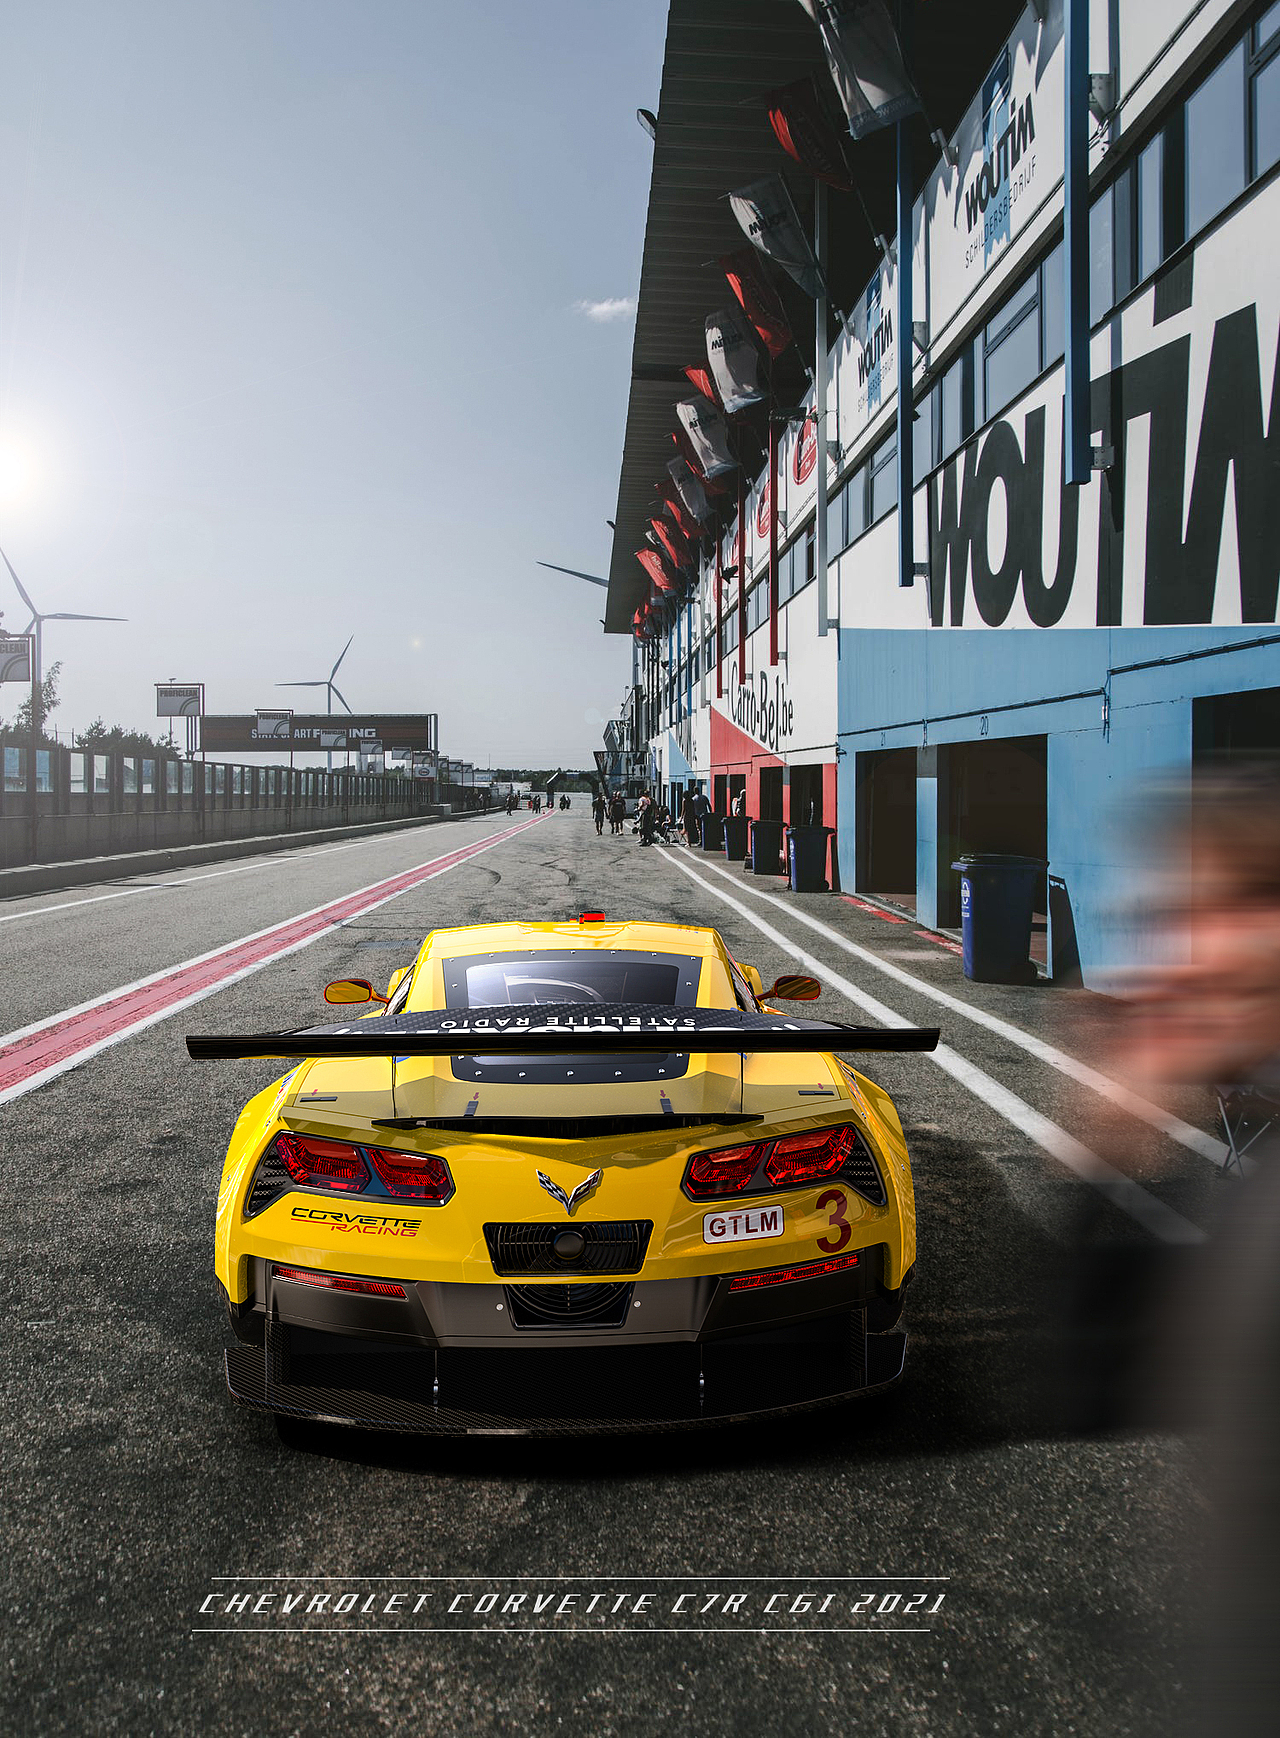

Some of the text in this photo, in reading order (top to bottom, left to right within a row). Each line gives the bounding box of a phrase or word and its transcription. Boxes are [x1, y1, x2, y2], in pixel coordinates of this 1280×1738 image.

[965, 155, 1037, 269] SCHILDERSBEDRIJF
[159, 689, 198, 698] PROFICLEAN
[312, 728, 377, 739] FING
[980, 715, 989, 736] 20
[440, 1017, 530, 1029] RADIO
[545, 1016, 696, 1027] SATELLITE
[291, 1207, 422, 1229] CORVETTE
[709, 1211, 778, 1237] GTLM
[815, 1189, 852, 1254] 3
[330, 1224, 419, 1237] RACING
